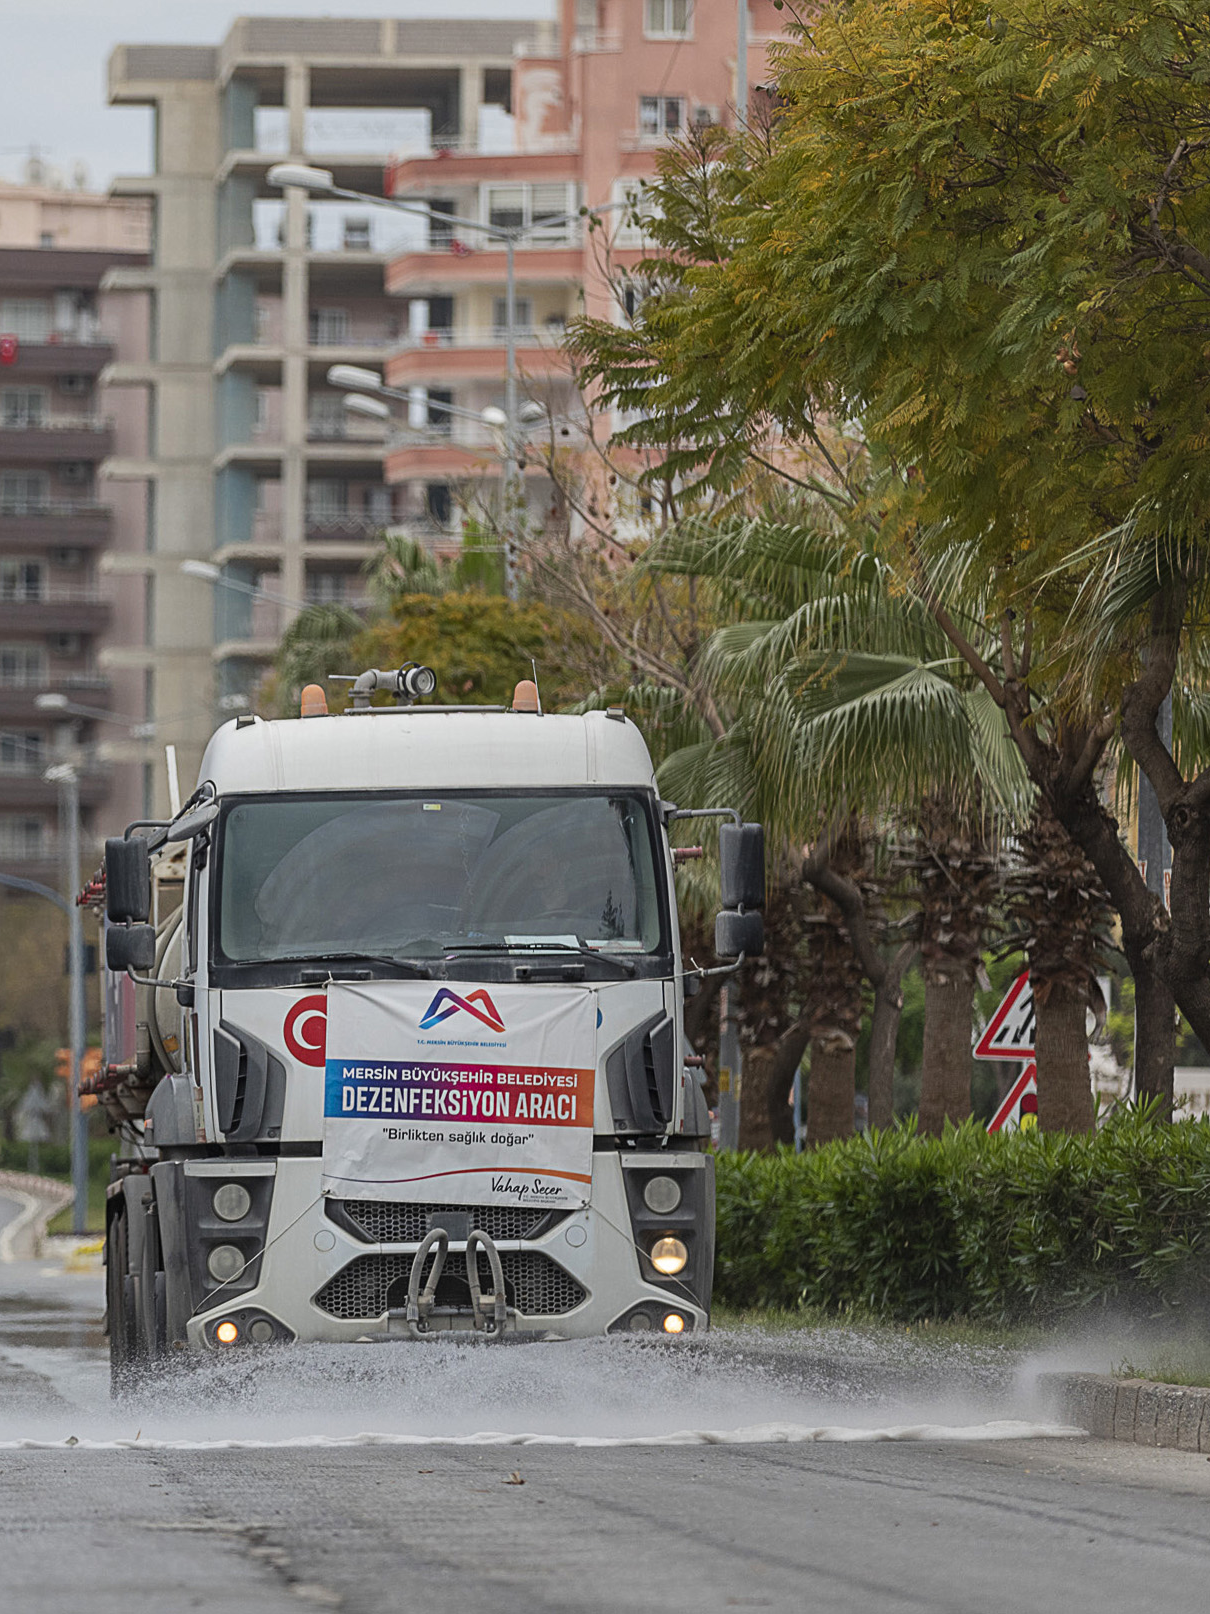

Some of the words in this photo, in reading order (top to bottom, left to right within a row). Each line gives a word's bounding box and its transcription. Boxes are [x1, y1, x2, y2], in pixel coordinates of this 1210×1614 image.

[342, 1065, 398, 1081] MERSİN
[401, 1067, 493, 1086] BÜYÜKŞEHİR
[497, 1071, 578, 1088] BELEDİYESİ
[514, 1092, 577, 1120] ARACI
[382, 1127, 444, 1142] "Birlikten
[448, 1131, 486, 1146] sağlık
[490, 1132, 534, 1147] doğar"
[491, 1175, 530, 1201] Vahap
